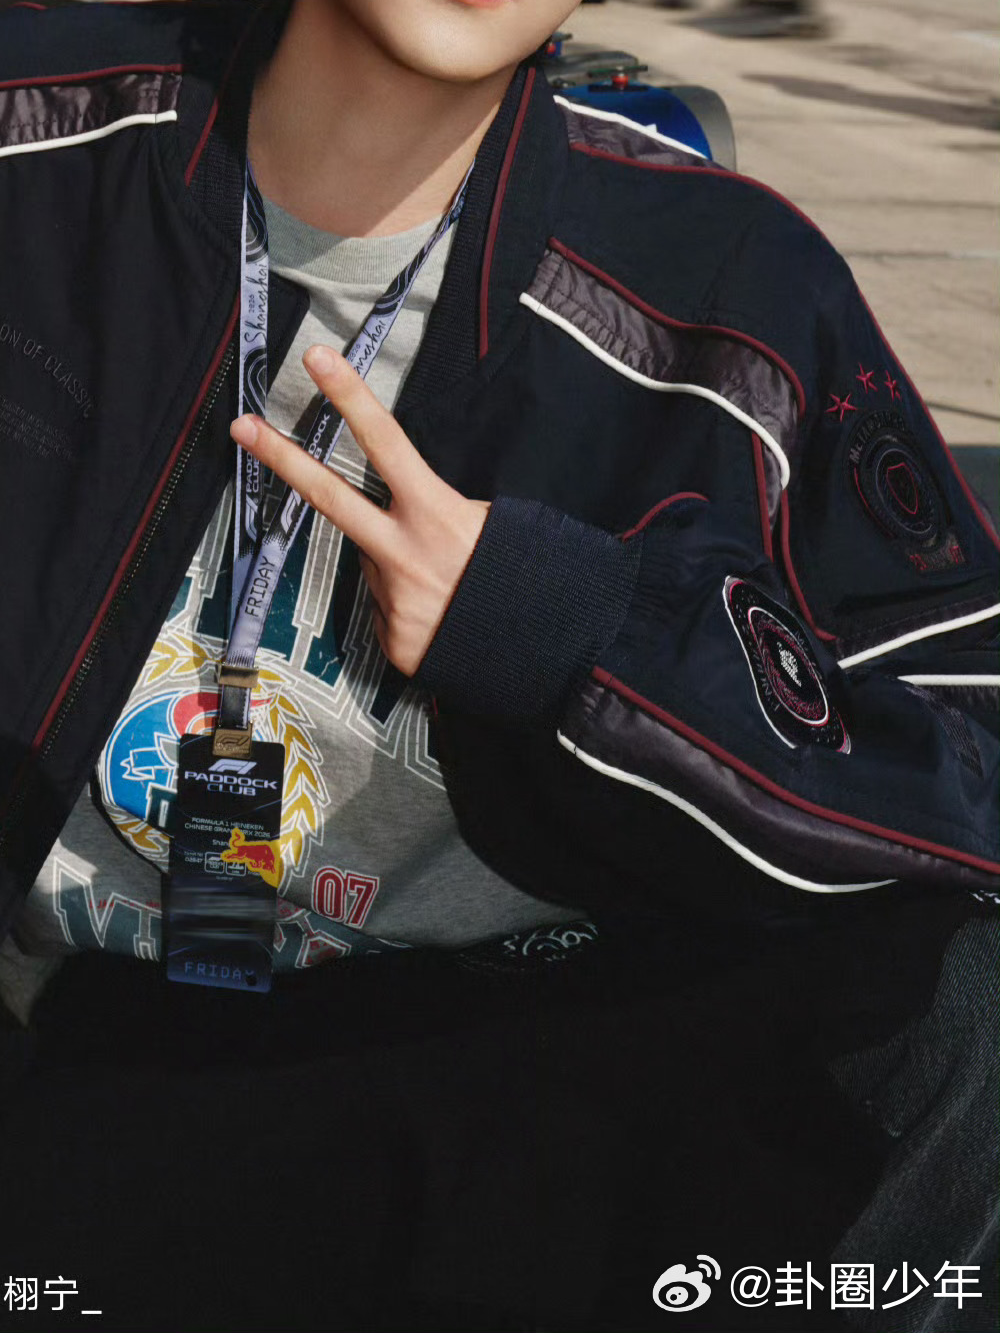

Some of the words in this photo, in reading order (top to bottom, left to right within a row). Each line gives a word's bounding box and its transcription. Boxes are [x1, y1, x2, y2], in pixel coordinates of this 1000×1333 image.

[245, 555, 276, 618] FRIDAY
[184, 771, 278, 790] PADDOCK
[207, 783, 256, 796] CLUB
[184, 823, 213, 832] CHINESE
[191, 817, 224, 826] FORMULA
[311, 865, 379, 929] 07
